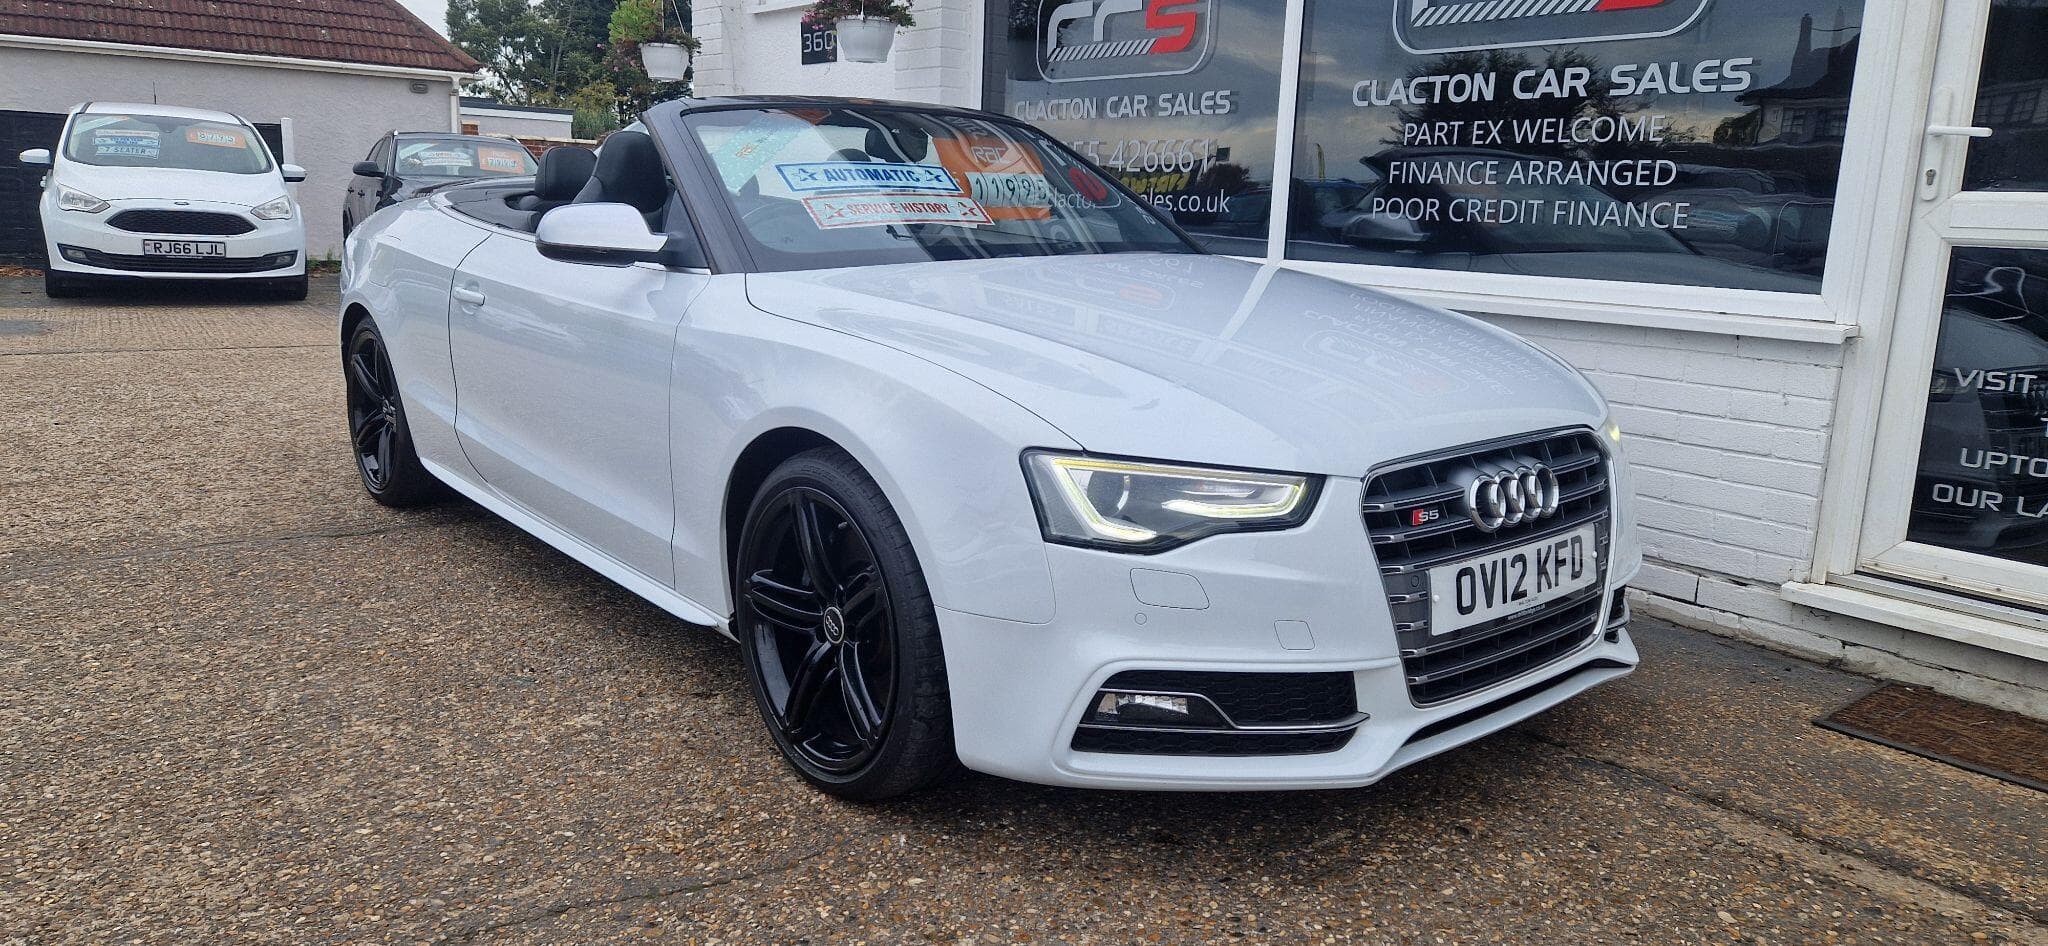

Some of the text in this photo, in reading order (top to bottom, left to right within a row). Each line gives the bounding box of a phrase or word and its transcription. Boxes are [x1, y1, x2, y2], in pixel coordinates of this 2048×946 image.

[1352, 57, 1754, 107] CLACTON CAR SALES
[1014, 90, 1231, 121] CLACTON CAR SALES
[1403, 115, 1667, 146] PART EX WELCOME
[1108, 138, 1211, 173] 426661
[825, 166, 921, 183] AUTOMATIC
[1388, 159, 1678, 187] FINANCE ARRANGED
[975, 177, 1047, 201] 11995
[847, 202, 951, 216] SERVICE HISTORY
[1372, 197, 1691, 230] POOR CREDIT FINANCE
[154, 242, 224, 255] RJ66 LJL
[1953, 367, 2038, 394] VISIT
[1932, 483, 2004, 512] OUR
[1418, 510, 1440, 522] S5
[1455, 534, 1584, 616] OV12 KFD
